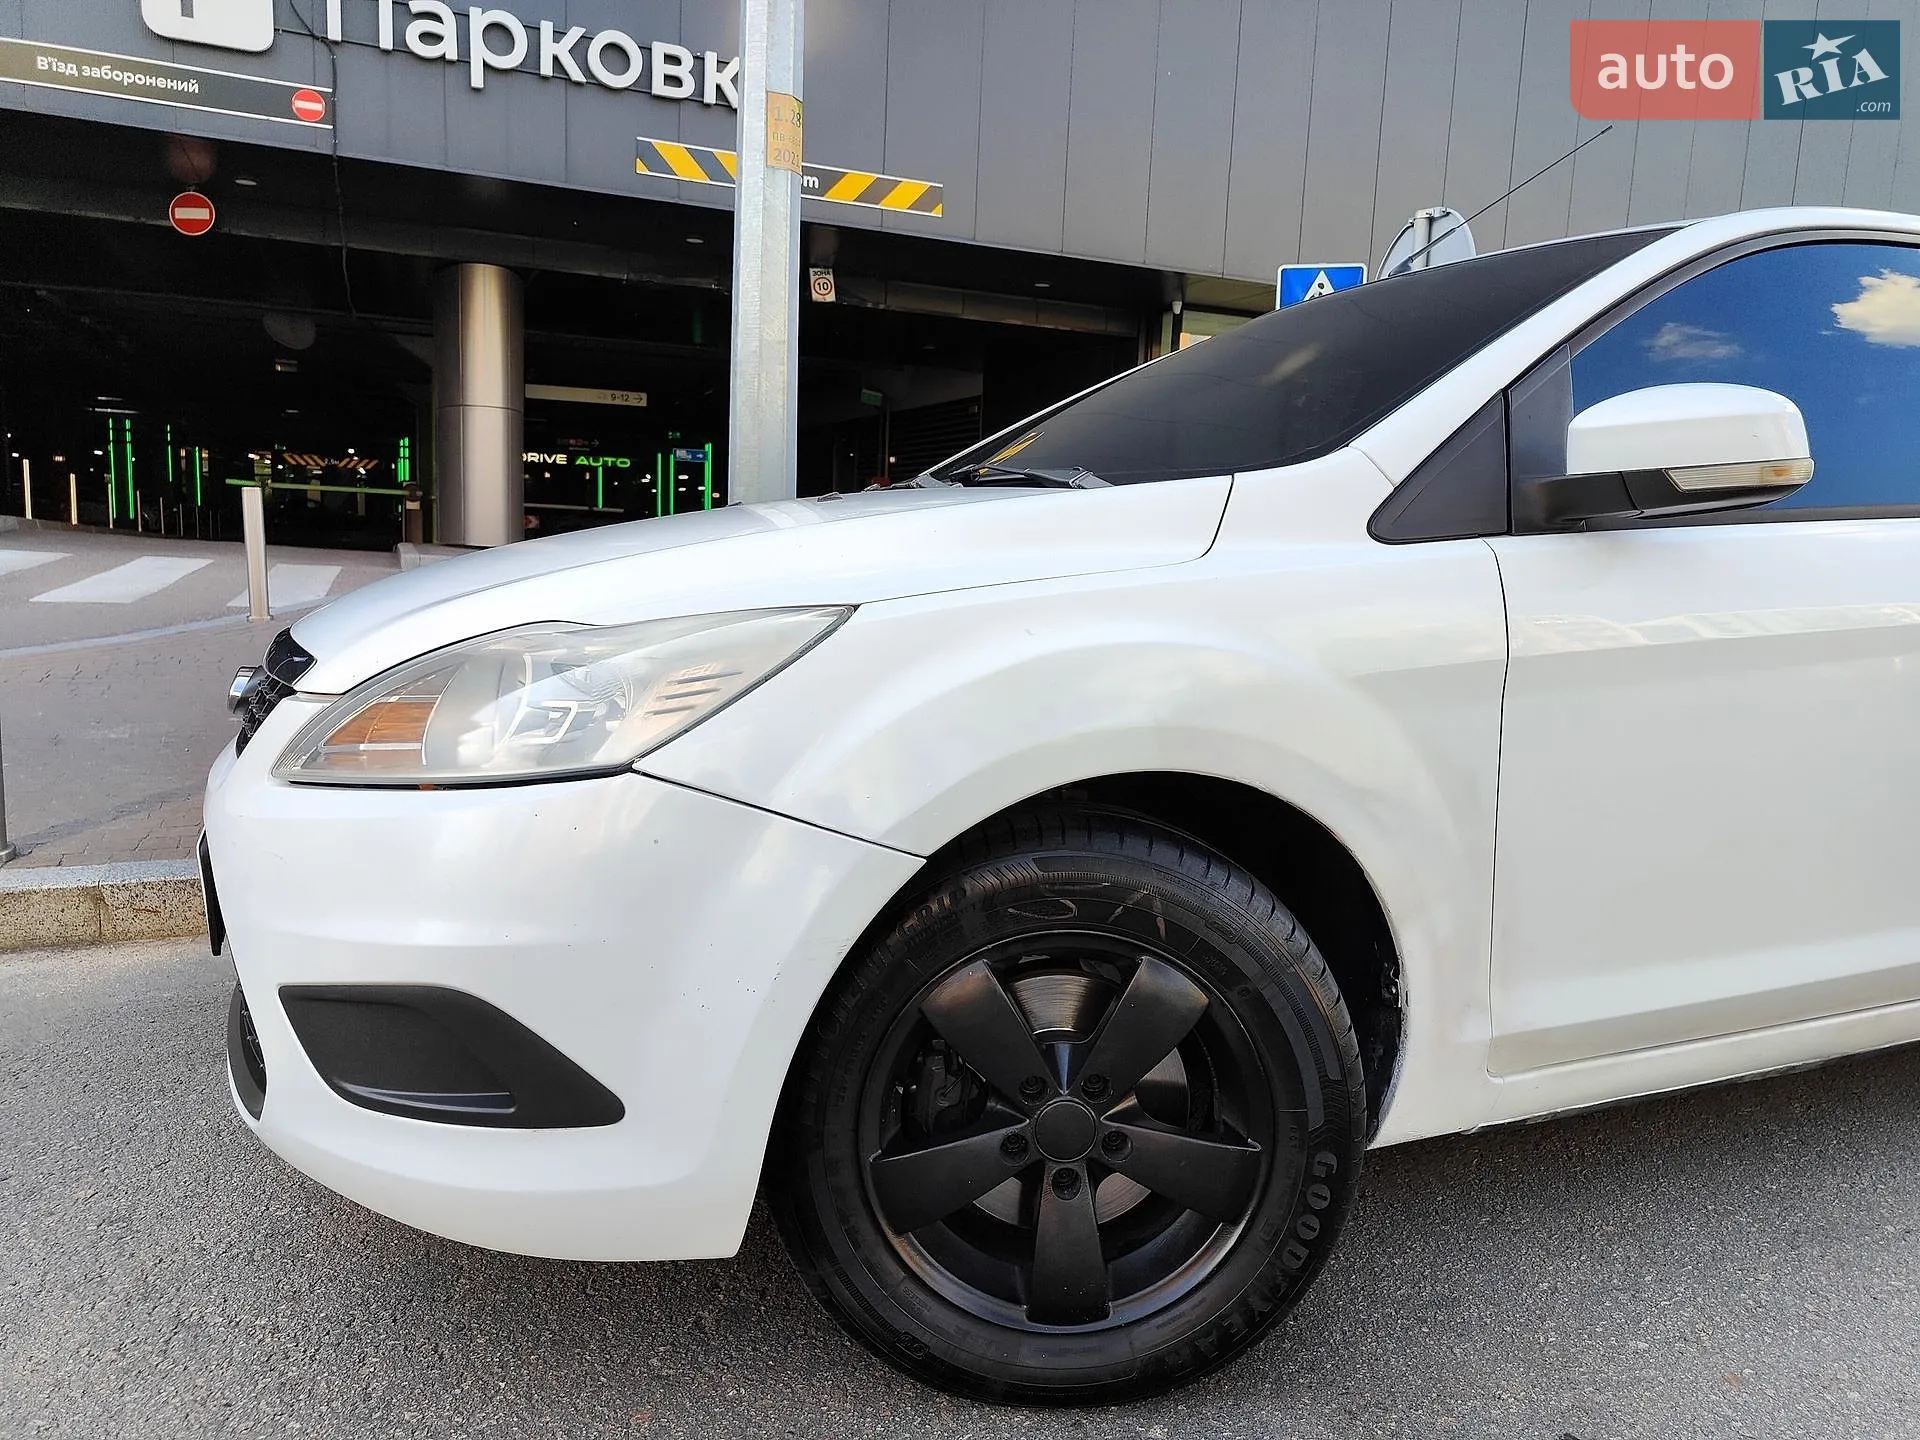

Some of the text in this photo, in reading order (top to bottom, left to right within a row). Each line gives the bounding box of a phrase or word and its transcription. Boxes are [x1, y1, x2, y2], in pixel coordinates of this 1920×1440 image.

[81, 66, 199, 94] заборонений
[816, 281, 829, 292] 10
[610, 393, 630, 402] 9-12
[575, 456, 631, 468] AUTO
